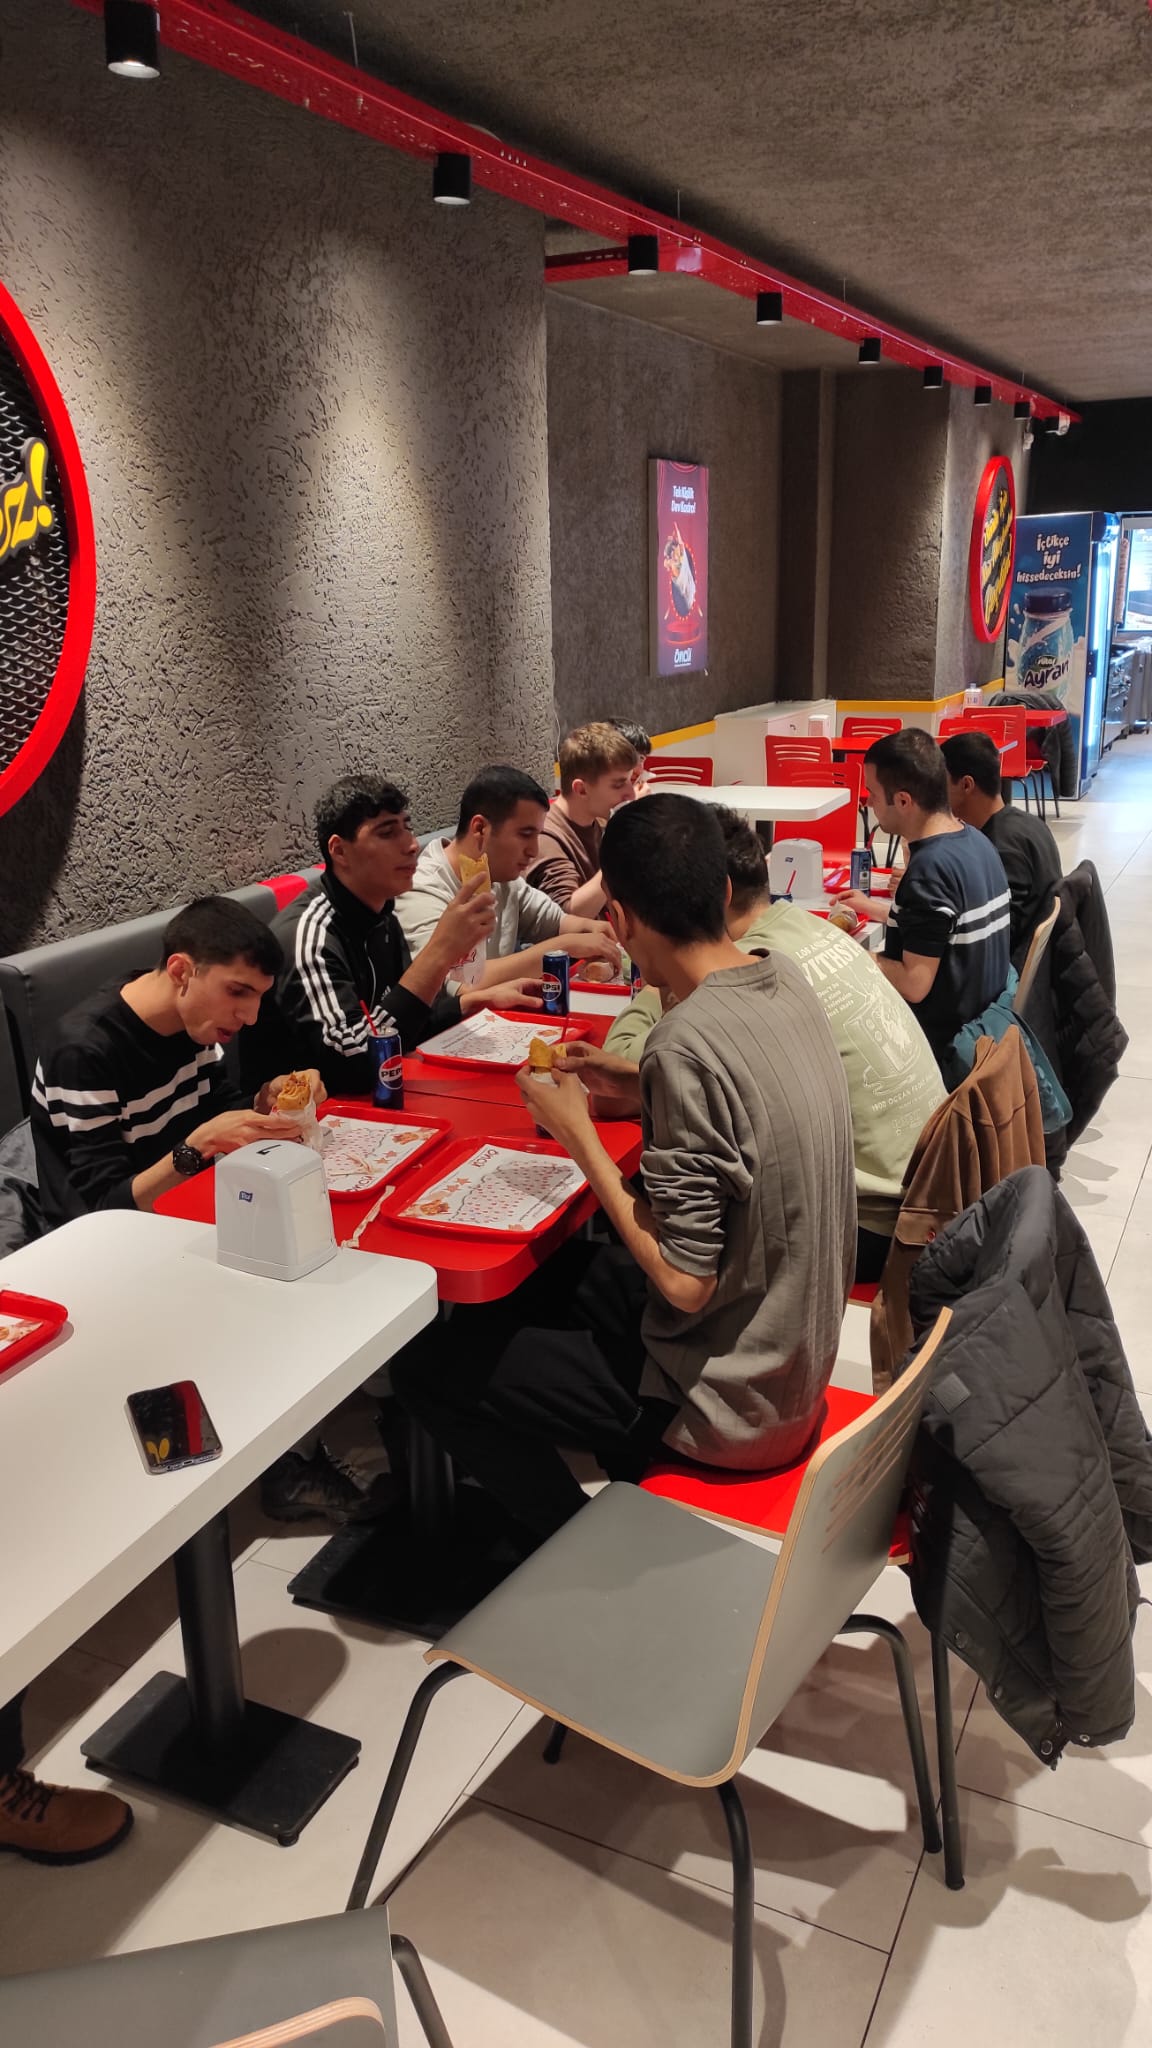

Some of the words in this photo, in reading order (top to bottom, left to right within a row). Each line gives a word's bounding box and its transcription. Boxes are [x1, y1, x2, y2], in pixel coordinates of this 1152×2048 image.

[1043, 550, 1061, 569] iyi
[1016, 563, 1081, 583] hissedeceksin!
[1024, 660, 1070, 688] Ayran
